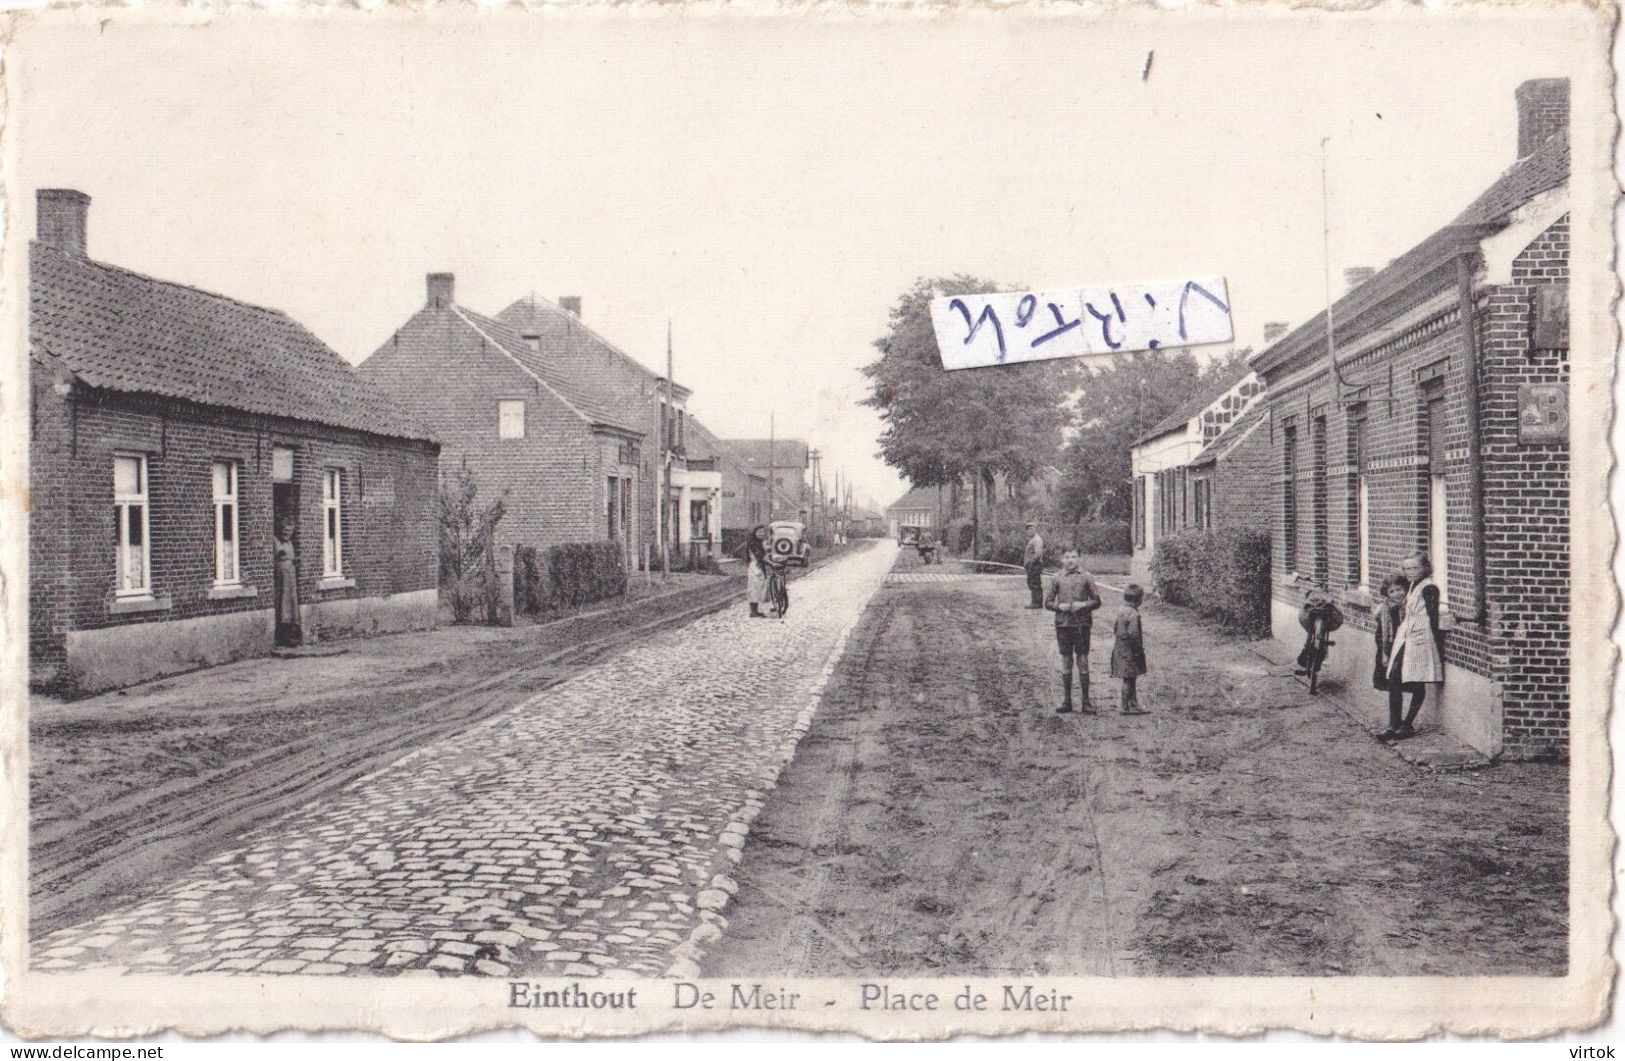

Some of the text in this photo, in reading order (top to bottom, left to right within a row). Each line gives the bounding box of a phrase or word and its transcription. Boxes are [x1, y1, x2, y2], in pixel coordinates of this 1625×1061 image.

[508, 983, 636, 1009] Einthout
[673, 983, 715, 1010] De
[731, 984, 800, 1010] Meir
[860, 984, 938, 1011] Place
[955, 985, 987, 1011] de
[1003, 985, 1072, 1011] Meir
